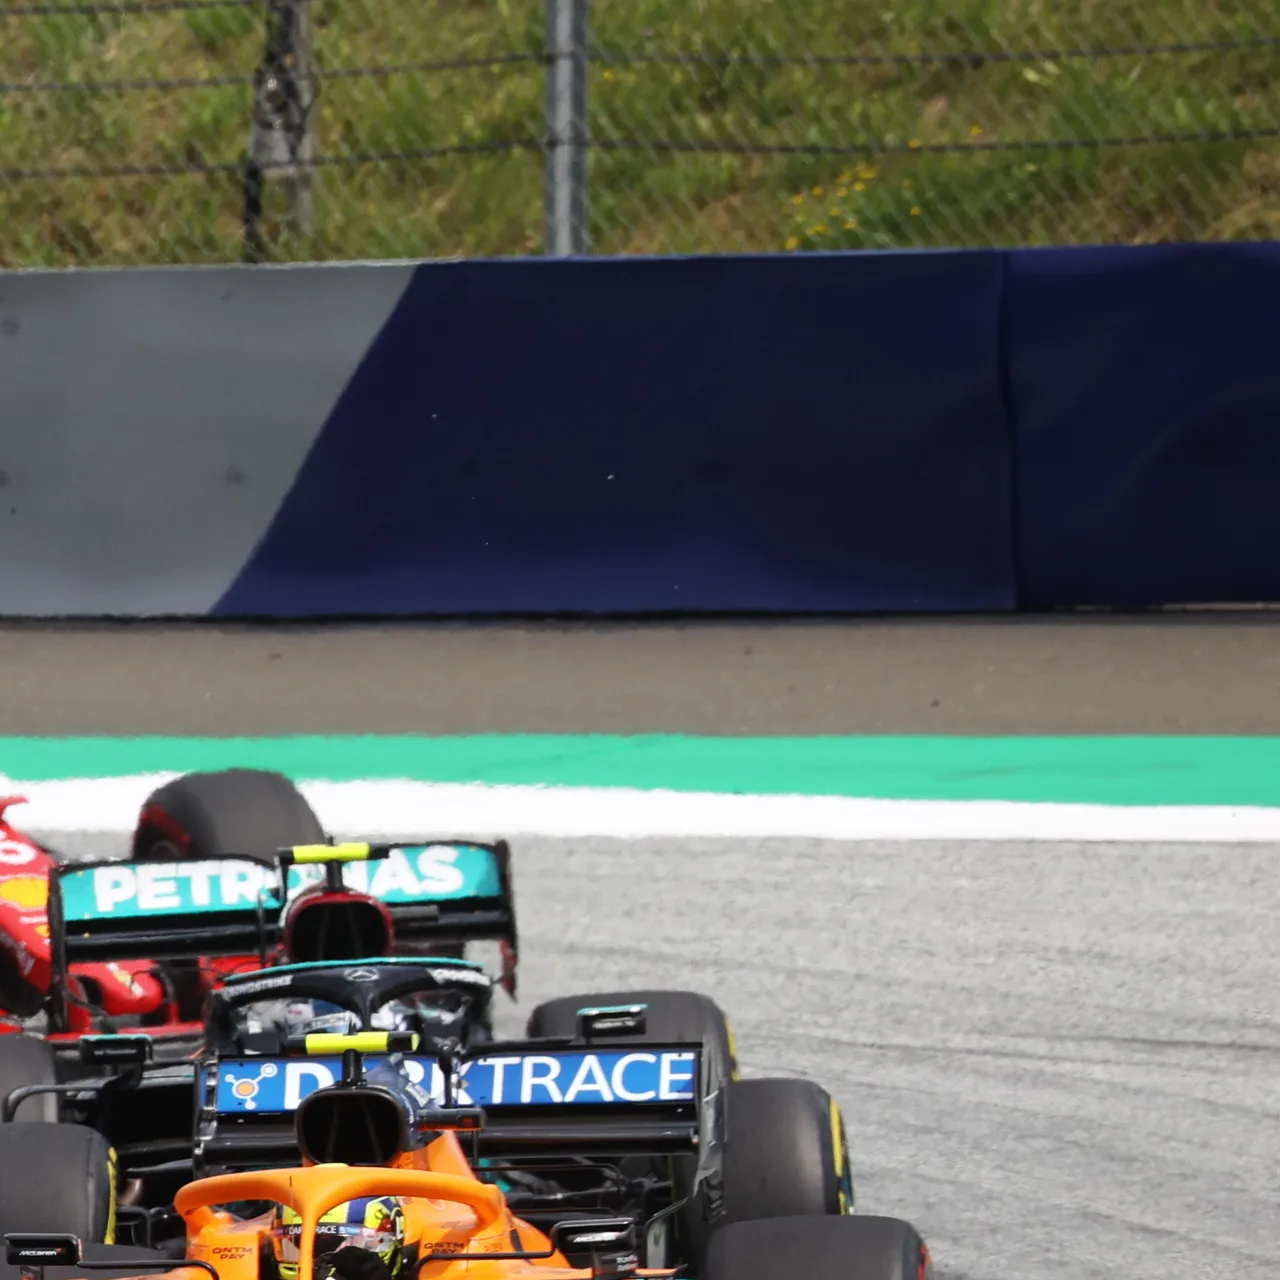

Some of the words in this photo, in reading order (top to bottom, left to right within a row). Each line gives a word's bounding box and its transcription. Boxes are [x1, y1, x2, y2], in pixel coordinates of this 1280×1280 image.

[93, 845, 464, 912] PETRAS
[284, 1052, 696, 1111] DKTRACE
[288, 1225, 337, 1236] DARACE
